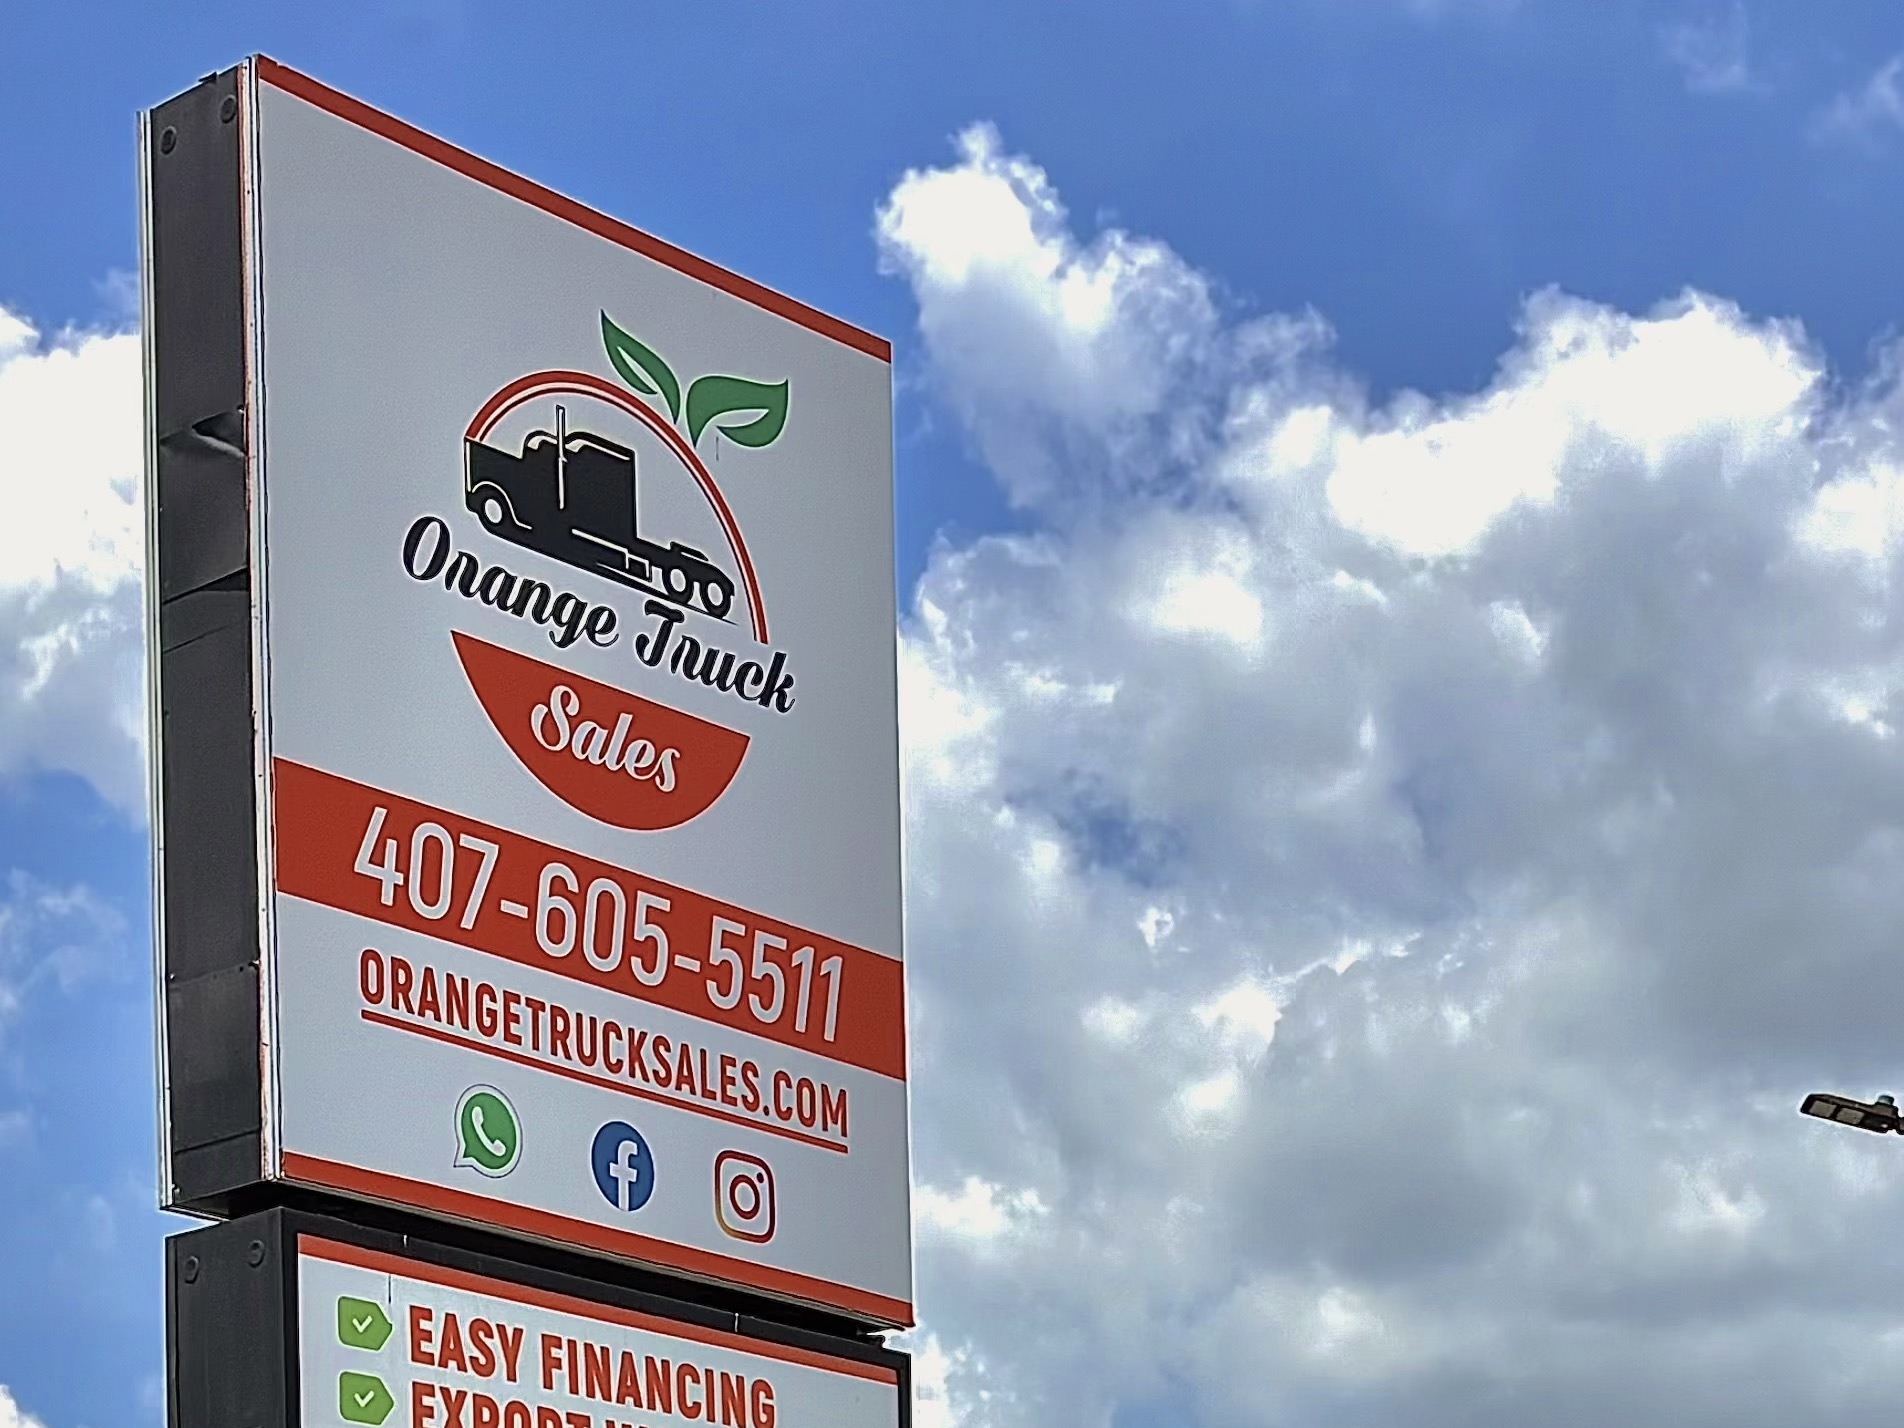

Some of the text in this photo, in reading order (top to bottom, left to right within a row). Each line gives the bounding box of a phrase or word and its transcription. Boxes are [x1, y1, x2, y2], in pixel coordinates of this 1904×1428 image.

[402, 515, 797, 714] Orange Truck
[530, 684, 681, 793] Sales
[353, 806, 844, 1043] 407-605-5511
[359, 948, 849, 1139] ORANGETRUCKSALES.COM
[408, 1305, 525, 1383] EASY
